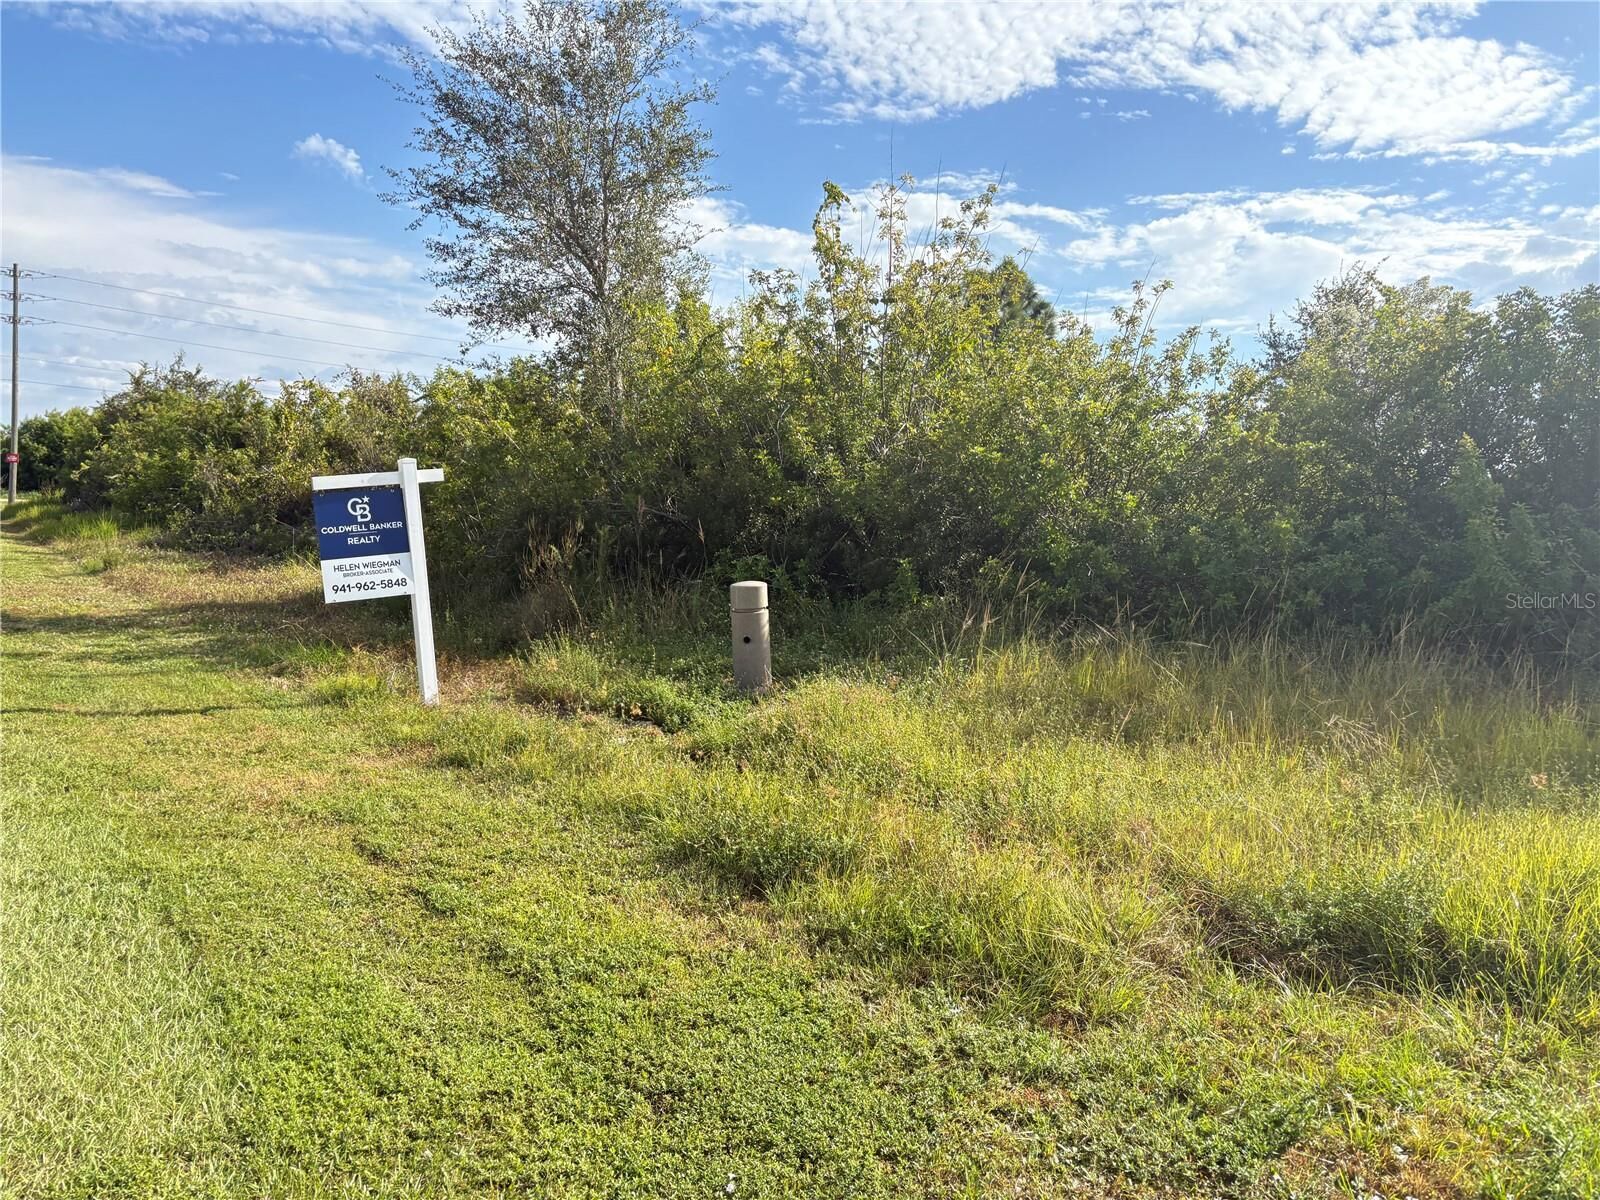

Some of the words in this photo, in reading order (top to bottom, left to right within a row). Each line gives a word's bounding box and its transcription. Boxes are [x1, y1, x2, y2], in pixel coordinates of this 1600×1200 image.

[321, 524, 367, 534] COLDWELL
[369, 521, 403, 530] BANKER
[347, 535, 381, 545] REALTY
[333, 563, 361, 572] HELEN
[361, 559, 401, 569] WIEGMAN
[343, 568, 393, 578] BROKER-ASSOCIATE
[331, 577, 408, 594] 941-962-5848
